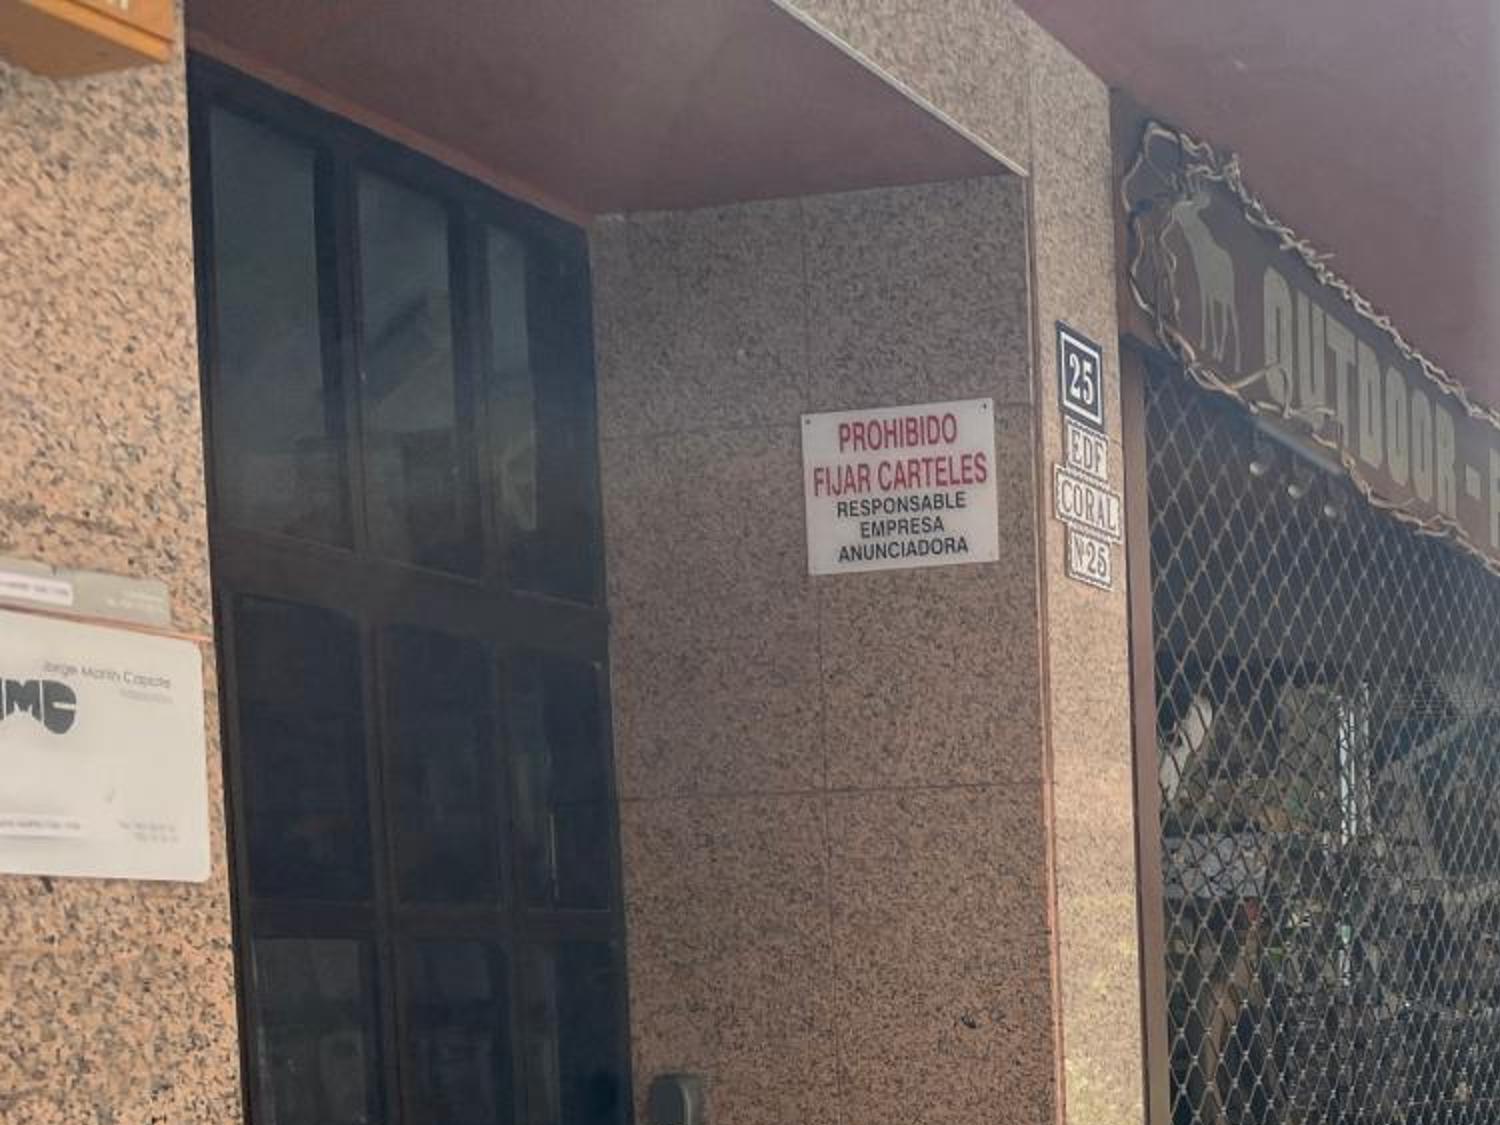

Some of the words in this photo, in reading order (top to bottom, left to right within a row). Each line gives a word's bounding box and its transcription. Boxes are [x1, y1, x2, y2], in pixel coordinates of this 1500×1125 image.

[1068, 352, 1094, 405] 25
[839, 413, 958, 453] PROHIBIDO
[813, 463, 872, 496] FIJAR
[877, 452, 988, 491] CARTELES
[837, 491, 967, 519] RESPONSABLE
[1060, 479, 1117, 531] CORAL
[860, 516, 945, 539] EMPRESA
[837, 536, 969, 563] ANUNCIADORA
